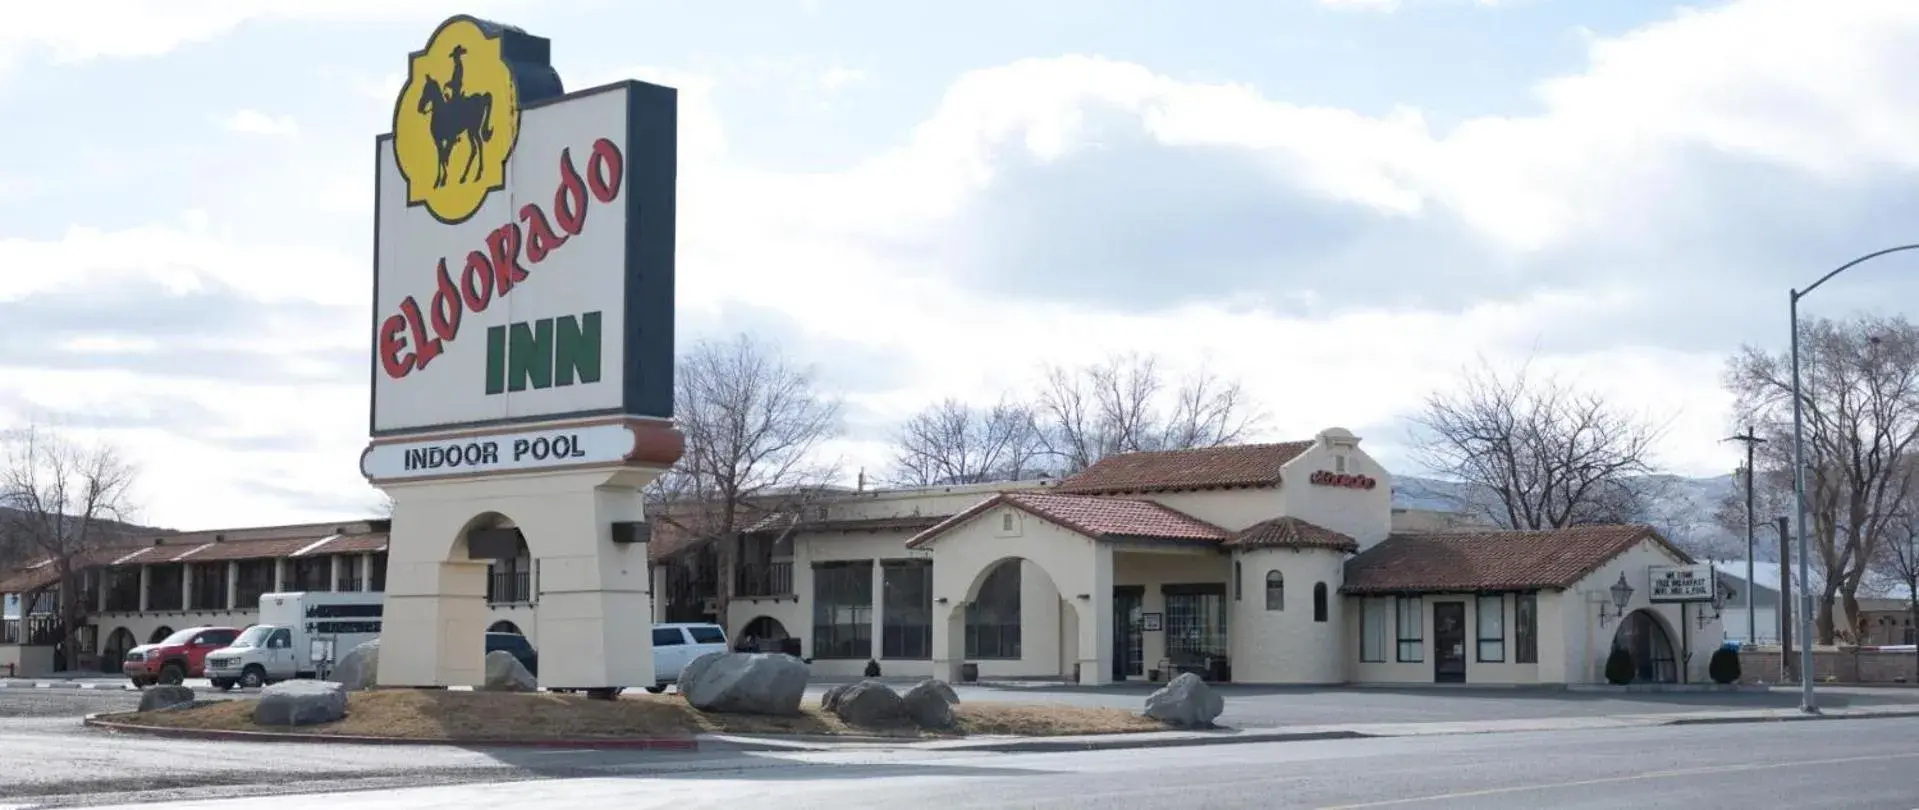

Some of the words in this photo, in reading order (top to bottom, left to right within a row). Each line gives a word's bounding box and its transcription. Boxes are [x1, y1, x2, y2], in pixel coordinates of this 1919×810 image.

[485, 310, 602, 395] INN
[405, 441, 498, 471] INDOOR
[514, 434, 586, 462] POOL
